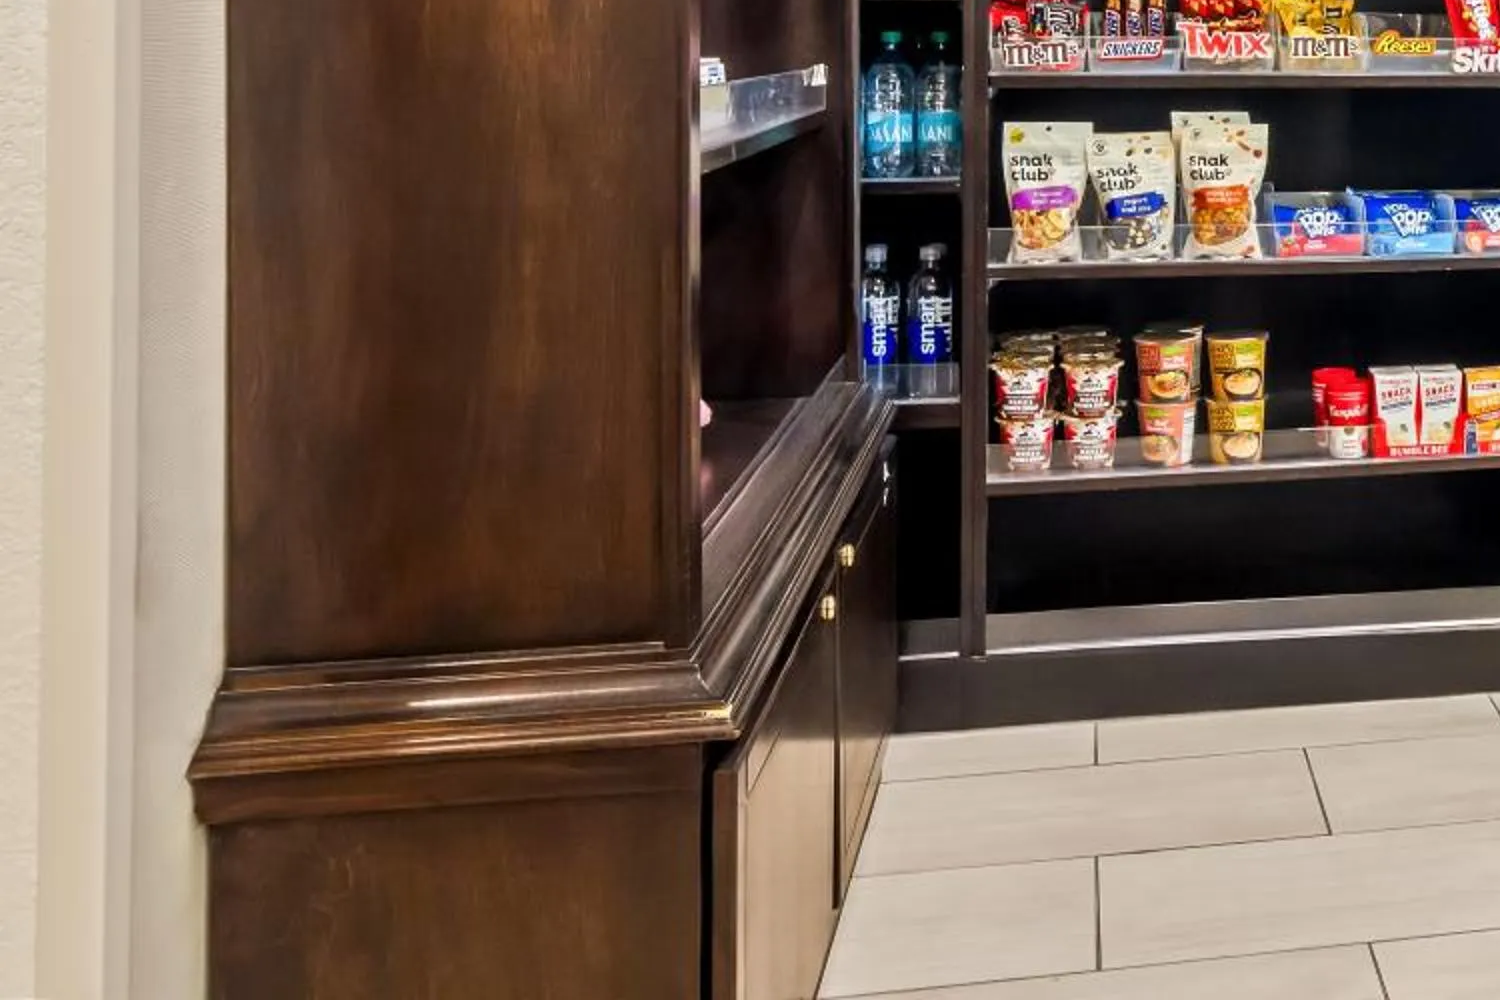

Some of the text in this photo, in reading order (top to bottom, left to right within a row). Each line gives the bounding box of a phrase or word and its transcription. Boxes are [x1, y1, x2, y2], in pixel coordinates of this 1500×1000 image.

[1010, 153, 1052, 167] snak
[1188, 154, 1229, 167] snak
[1011, 166, 1050, 181] club
[1096, 163, 1139, 179] snak
[1189, 166, 1225, 181] club
[1100, 177, 1136, 193] club
[872, 295, 888, 357] smart
[920, 296, 936, 355] smart
